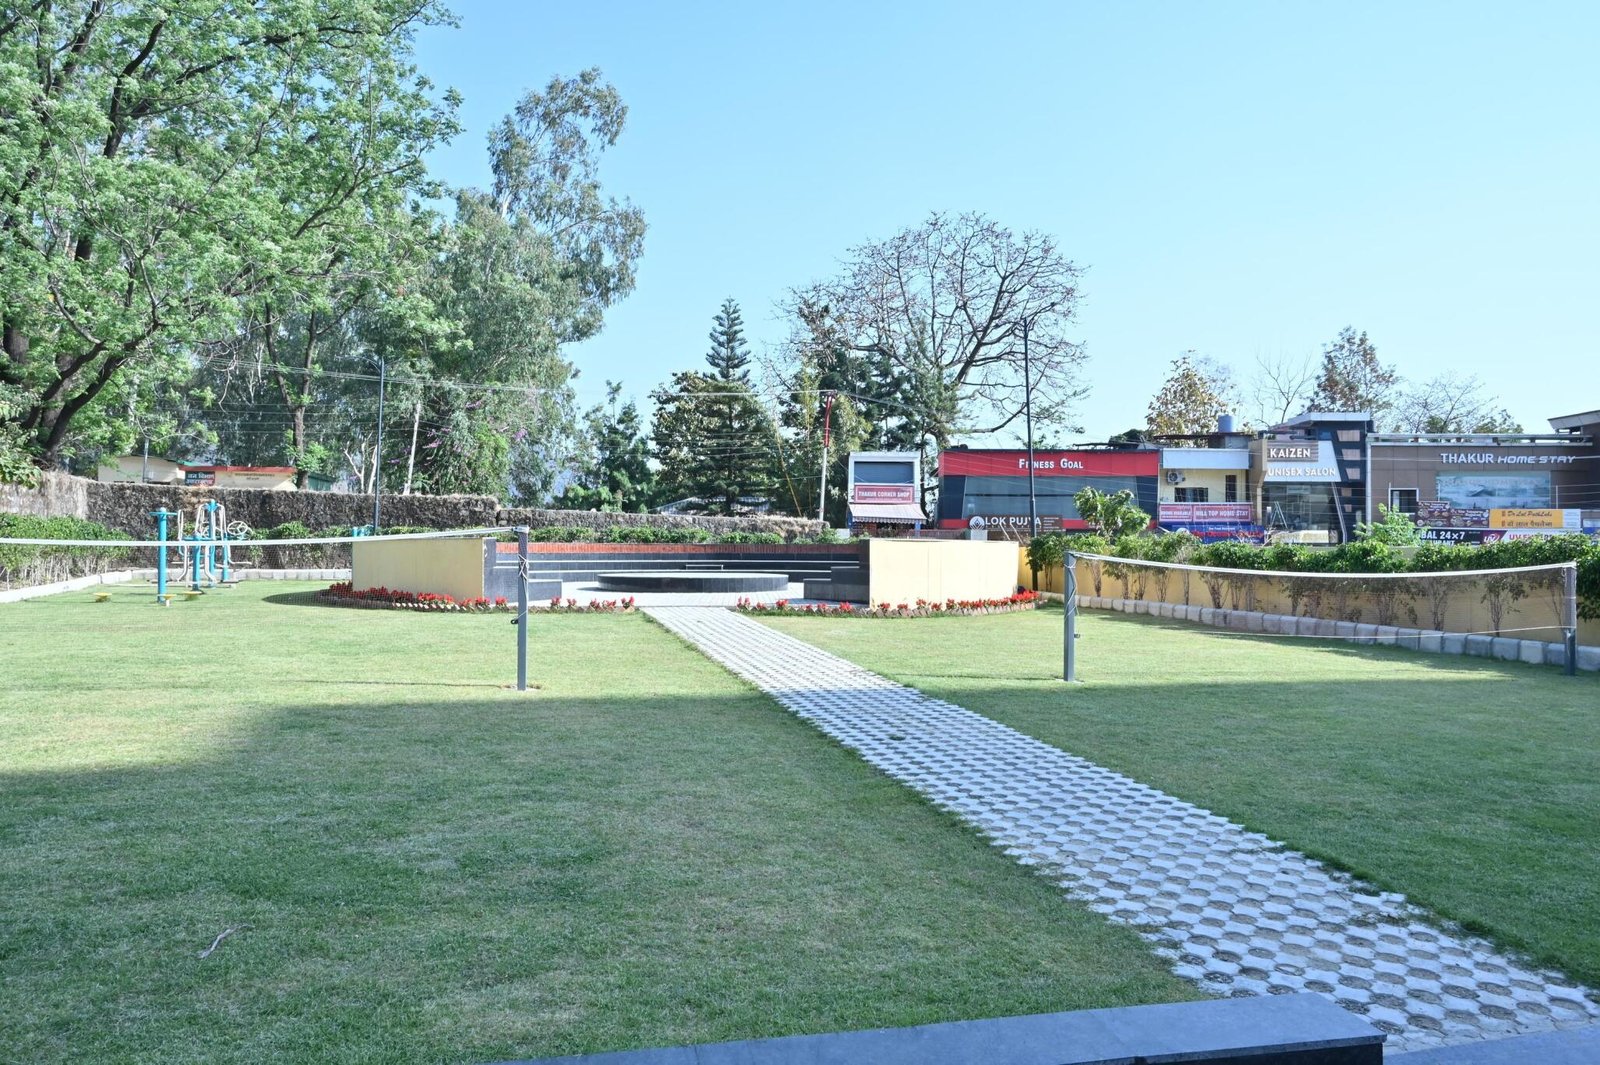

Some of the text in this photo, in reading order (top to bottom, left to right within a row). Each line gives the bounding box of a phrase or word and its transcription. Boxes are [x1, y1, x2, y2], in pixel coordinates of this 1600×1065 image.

[1270, 448, 1311, 458] KAIZEN
[1018, 458, 1055, 469] FINESS
[1440, 453, 1576, 464] THAKUR HOME STAY
[1268, 467, 1336, 476] UNISEX SALON
[985, 516, 1006, 525] LOK
